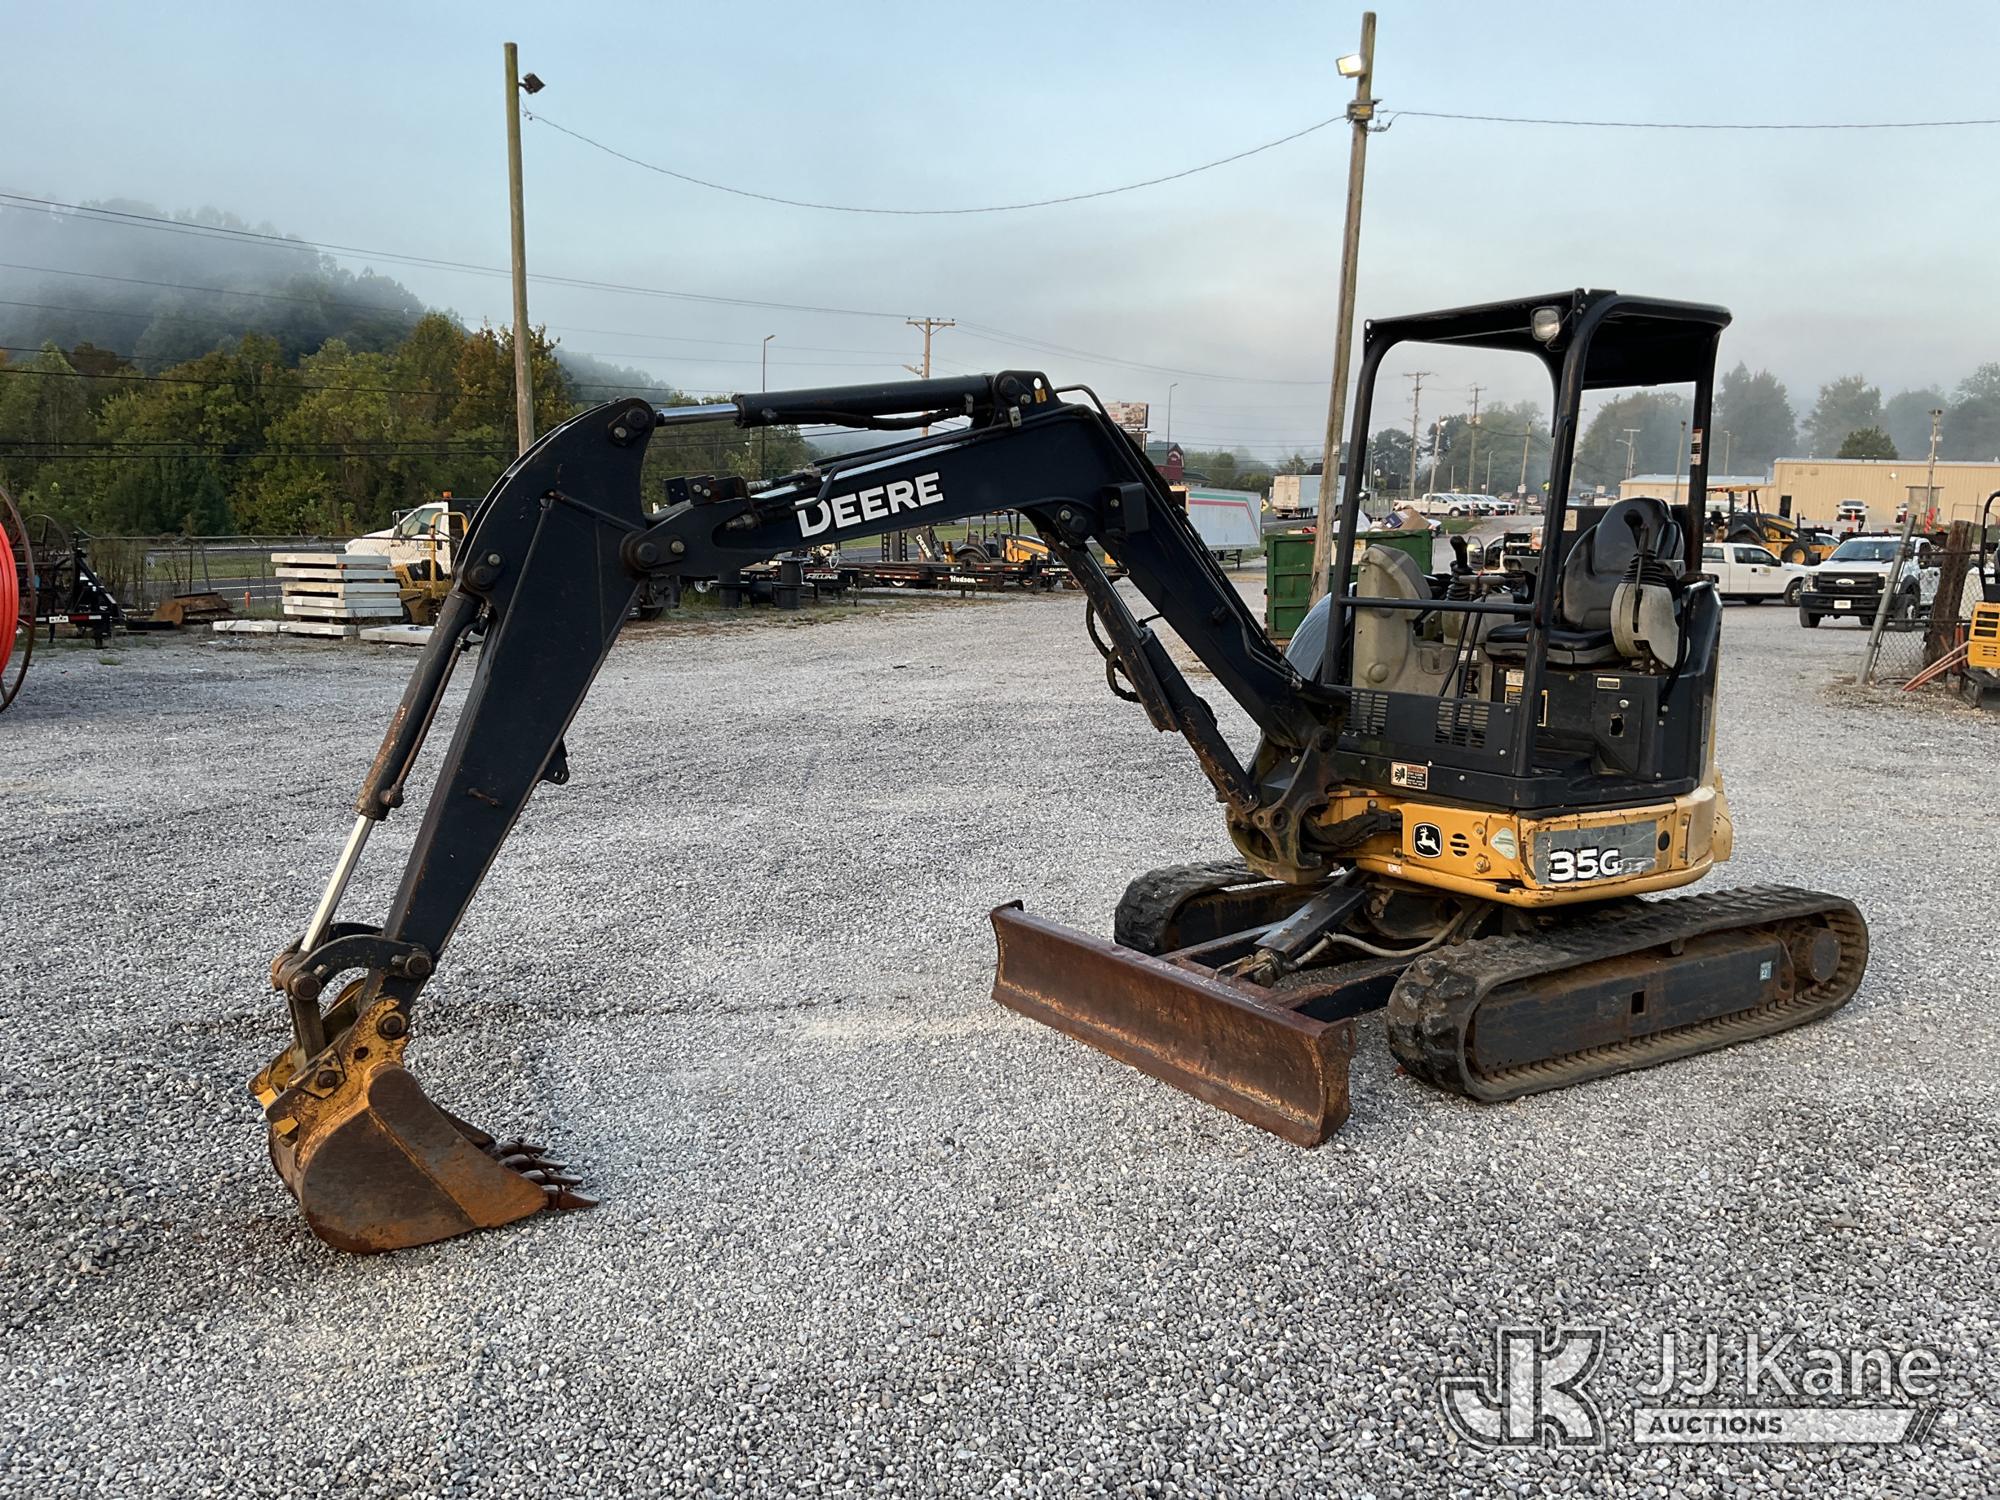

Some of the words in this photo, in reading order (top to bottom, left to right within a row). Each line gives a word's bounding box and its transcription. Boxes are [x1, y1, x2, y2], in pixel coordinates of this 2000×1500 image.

[795, 472, 944, 538] DEERE
[949, 575, 977, 584] Hudson
[1549, 849, 1620, 882] 35G
